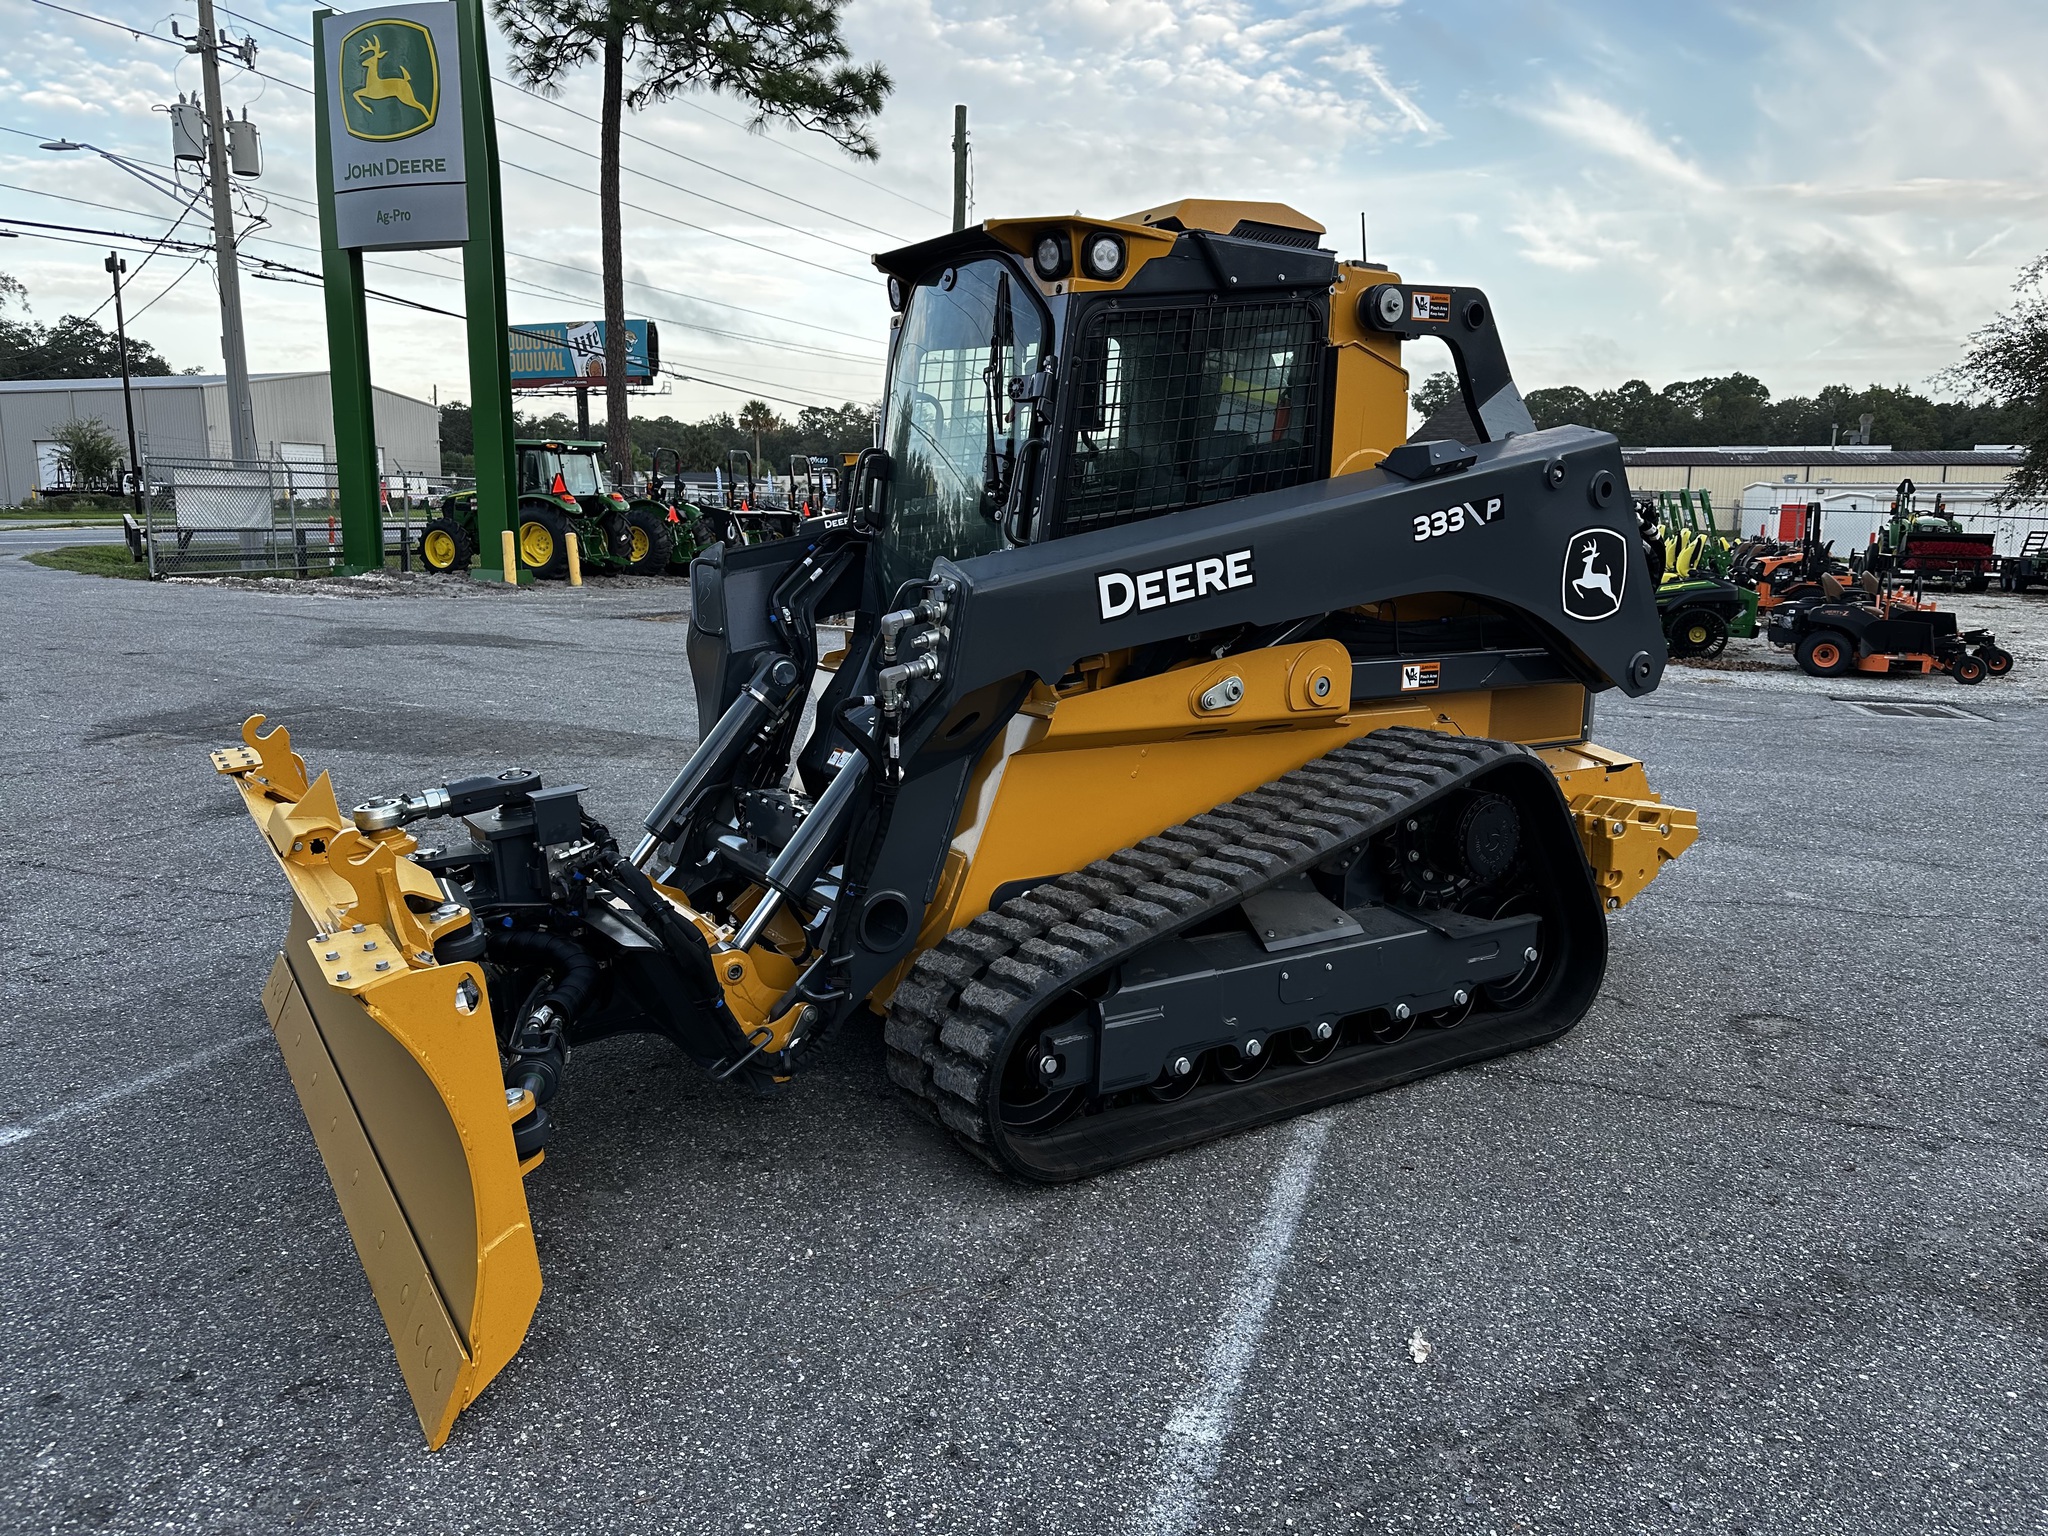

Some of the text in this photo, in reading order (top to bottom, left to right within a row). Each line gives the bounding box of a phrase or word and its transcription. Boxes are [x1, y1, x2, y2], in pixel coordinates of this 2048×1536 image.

[344, 158, 447, 181] JOHN DEERE
[376, 209, 411, 225] Ag-Pro
[573, 330, 600, 357] Lite
[1098, 550, 1254, 620] DEERE
